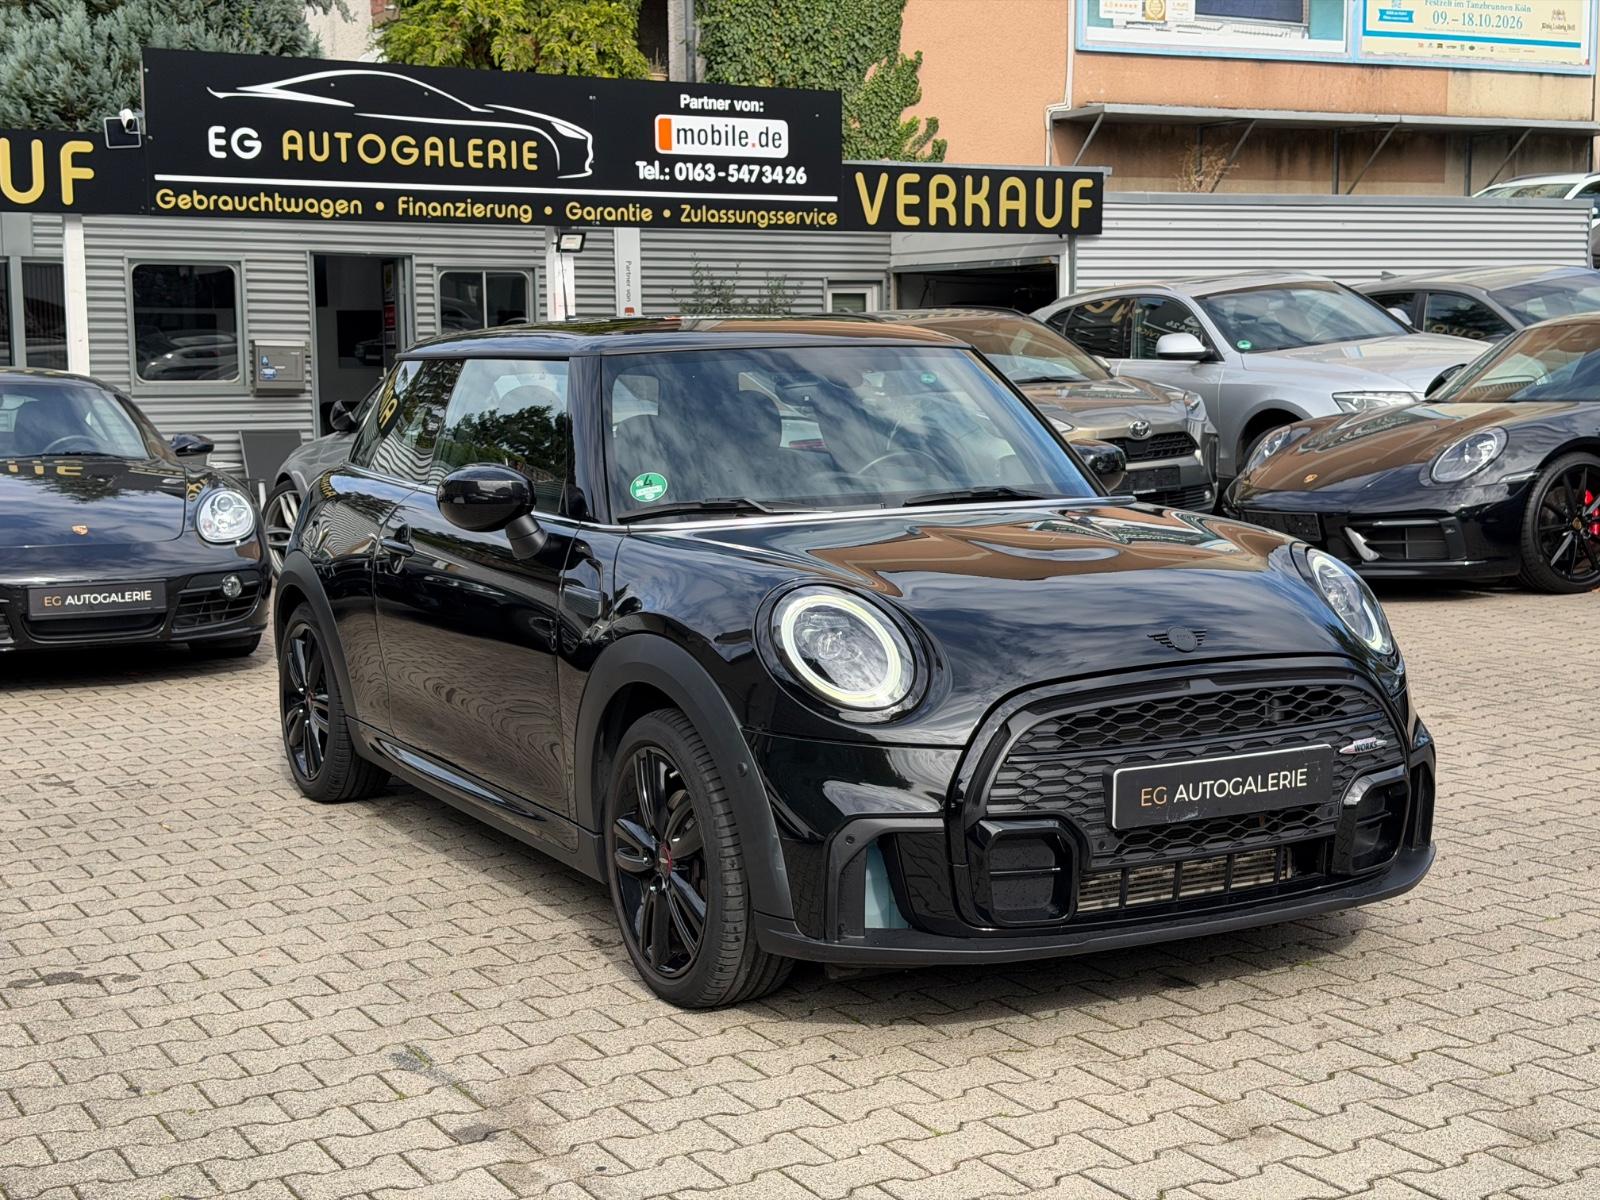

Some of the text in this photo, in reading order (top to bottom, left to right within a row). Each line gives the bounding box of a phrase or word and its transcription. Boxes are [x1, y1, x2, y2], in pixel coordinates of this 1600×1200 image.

[679, 94, 764, 113] Partner von:
[676, 124, 783, 149] mobile.de
[208, 126, 539, 171] EG AUTOGALERIE
[635, 160, 670, 181] Tel.:
[155, 188, 838, 228] Gebrauchtwagen Finanzierung Garantie Zulassungsservice
[854, 171, 1095, 229] VERKAUF
[643, 475, 653, 487] 4
[44, 590, 152, 607] EG AUTOGALERIE
[1354, 741, 1377, 751] WORKS
[1140, 768, 1308, 807] EG AUTOGALERIE
